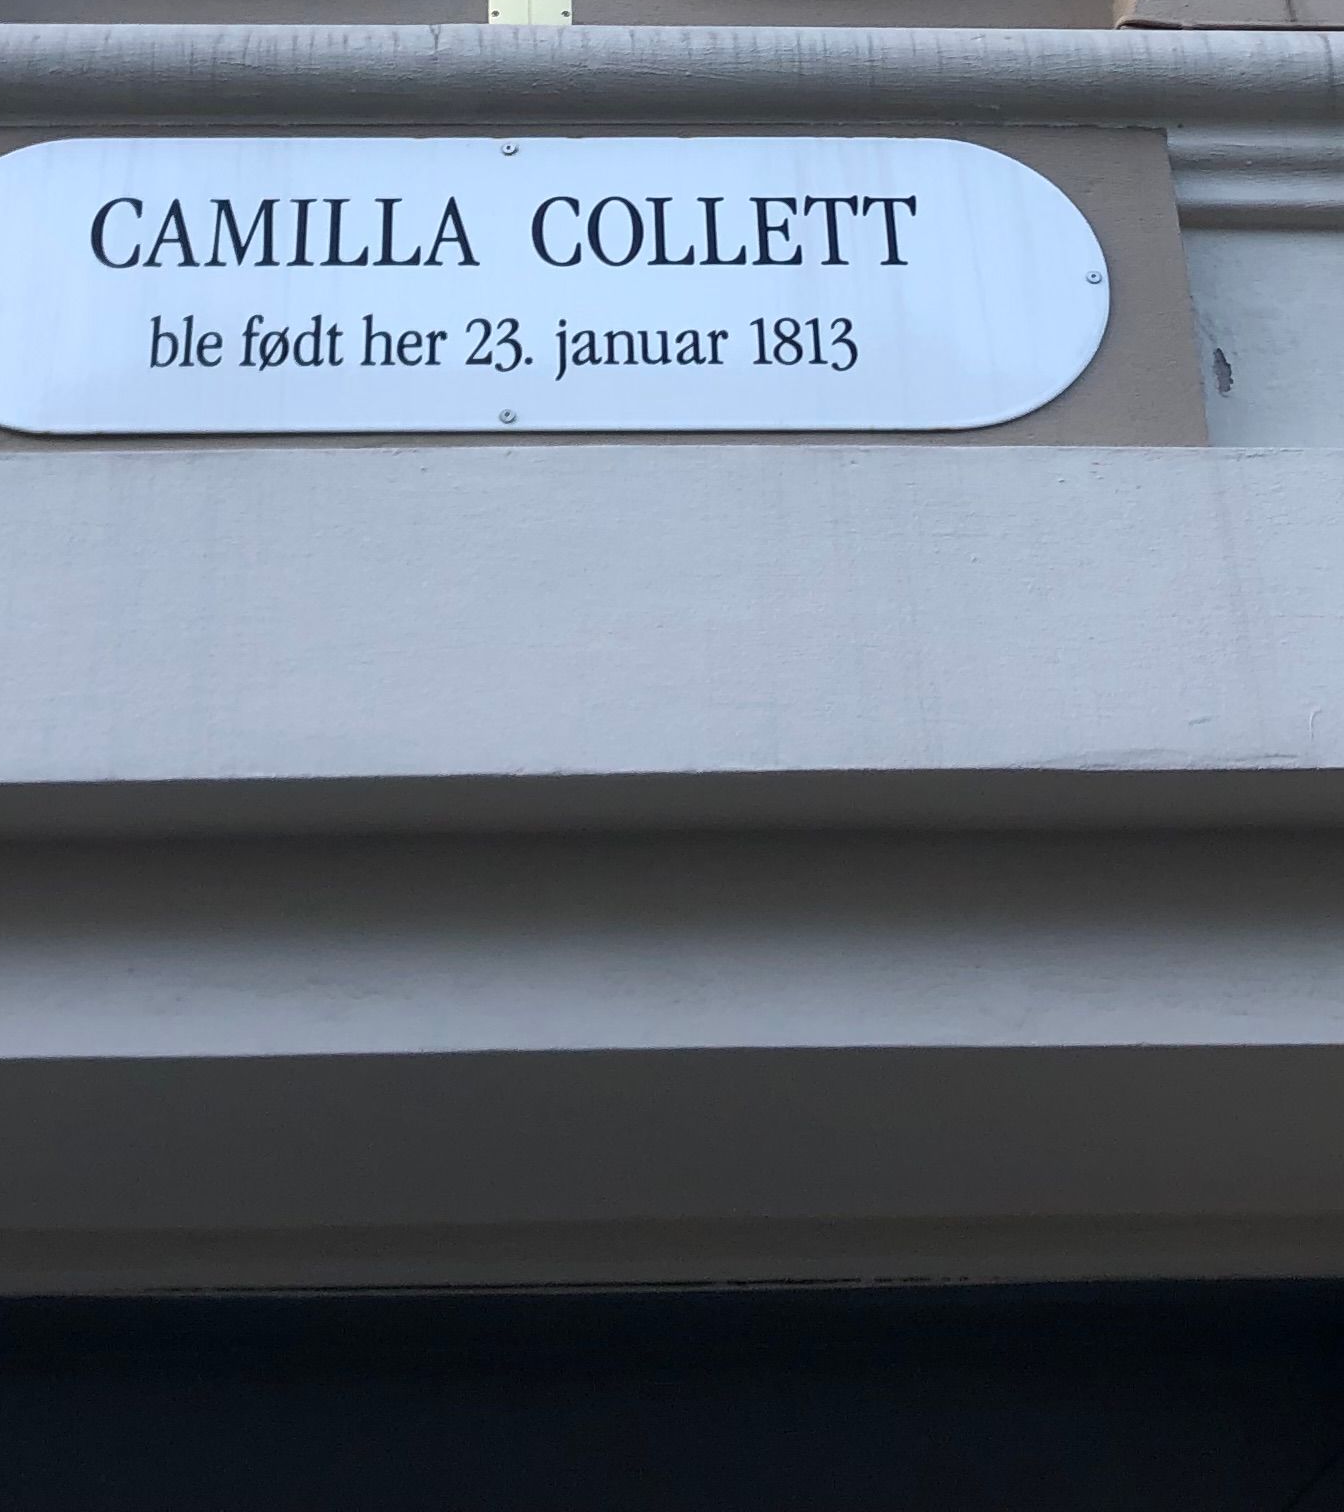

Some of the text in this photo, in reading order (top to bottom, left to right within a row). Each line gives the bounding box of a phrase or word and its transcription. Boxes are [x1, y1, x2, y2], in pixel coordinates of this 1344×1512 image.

[90, 194, 917, 269] CAMILLA COLLETT
[150, 314, 859, 379] ble født her 23. januar 1813
